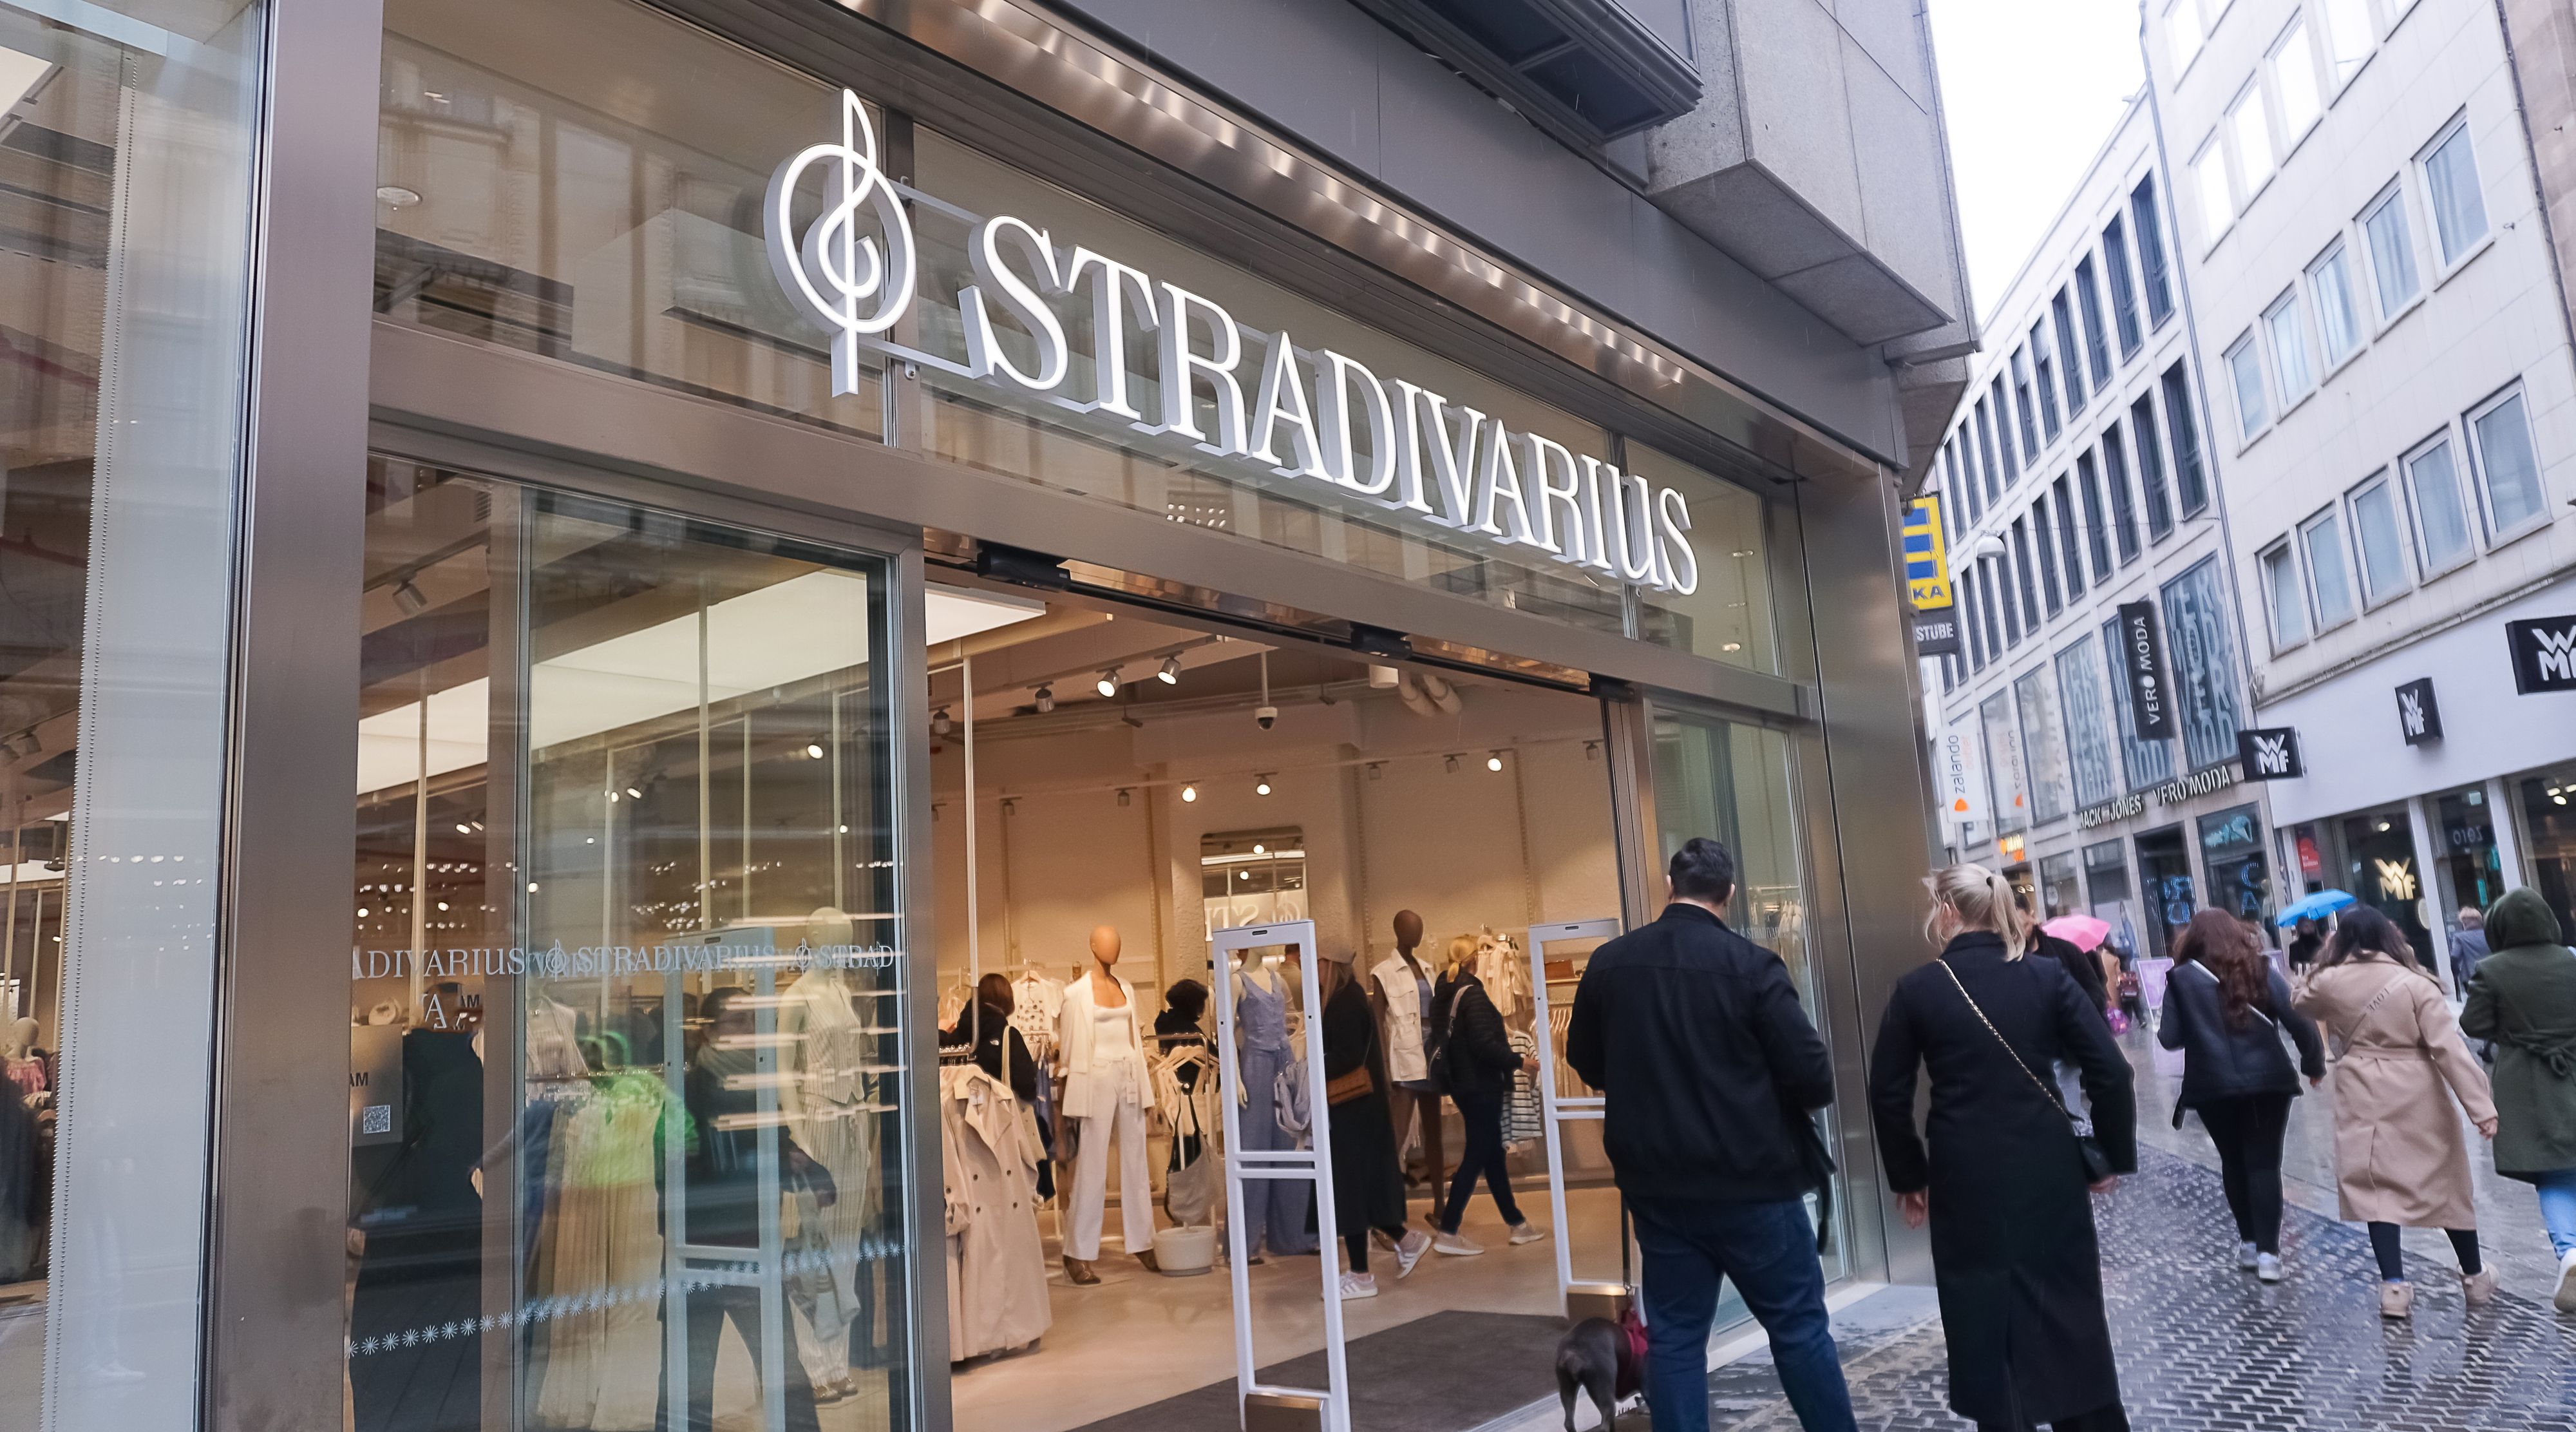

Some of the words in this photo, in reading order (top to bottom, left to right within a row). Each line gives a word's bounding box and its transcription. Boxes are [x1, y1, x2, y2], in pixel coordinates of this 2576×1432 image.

[959, 215, 1698, 597] STRADIVARIUS
[1915, 623, 1954, 642] STUBE
[2134, 616, 2153, 671] MODA
[2401, 688, 2425, 736] WMF
[1947, 734, 1966, 794] zalando
[2255, 734, 2289, 774] WMF
[2190, 765, 2231, 796] MODA
[2110, 794, 2142, 821] JONES
[2374, 857, 2416, 901] WMF
